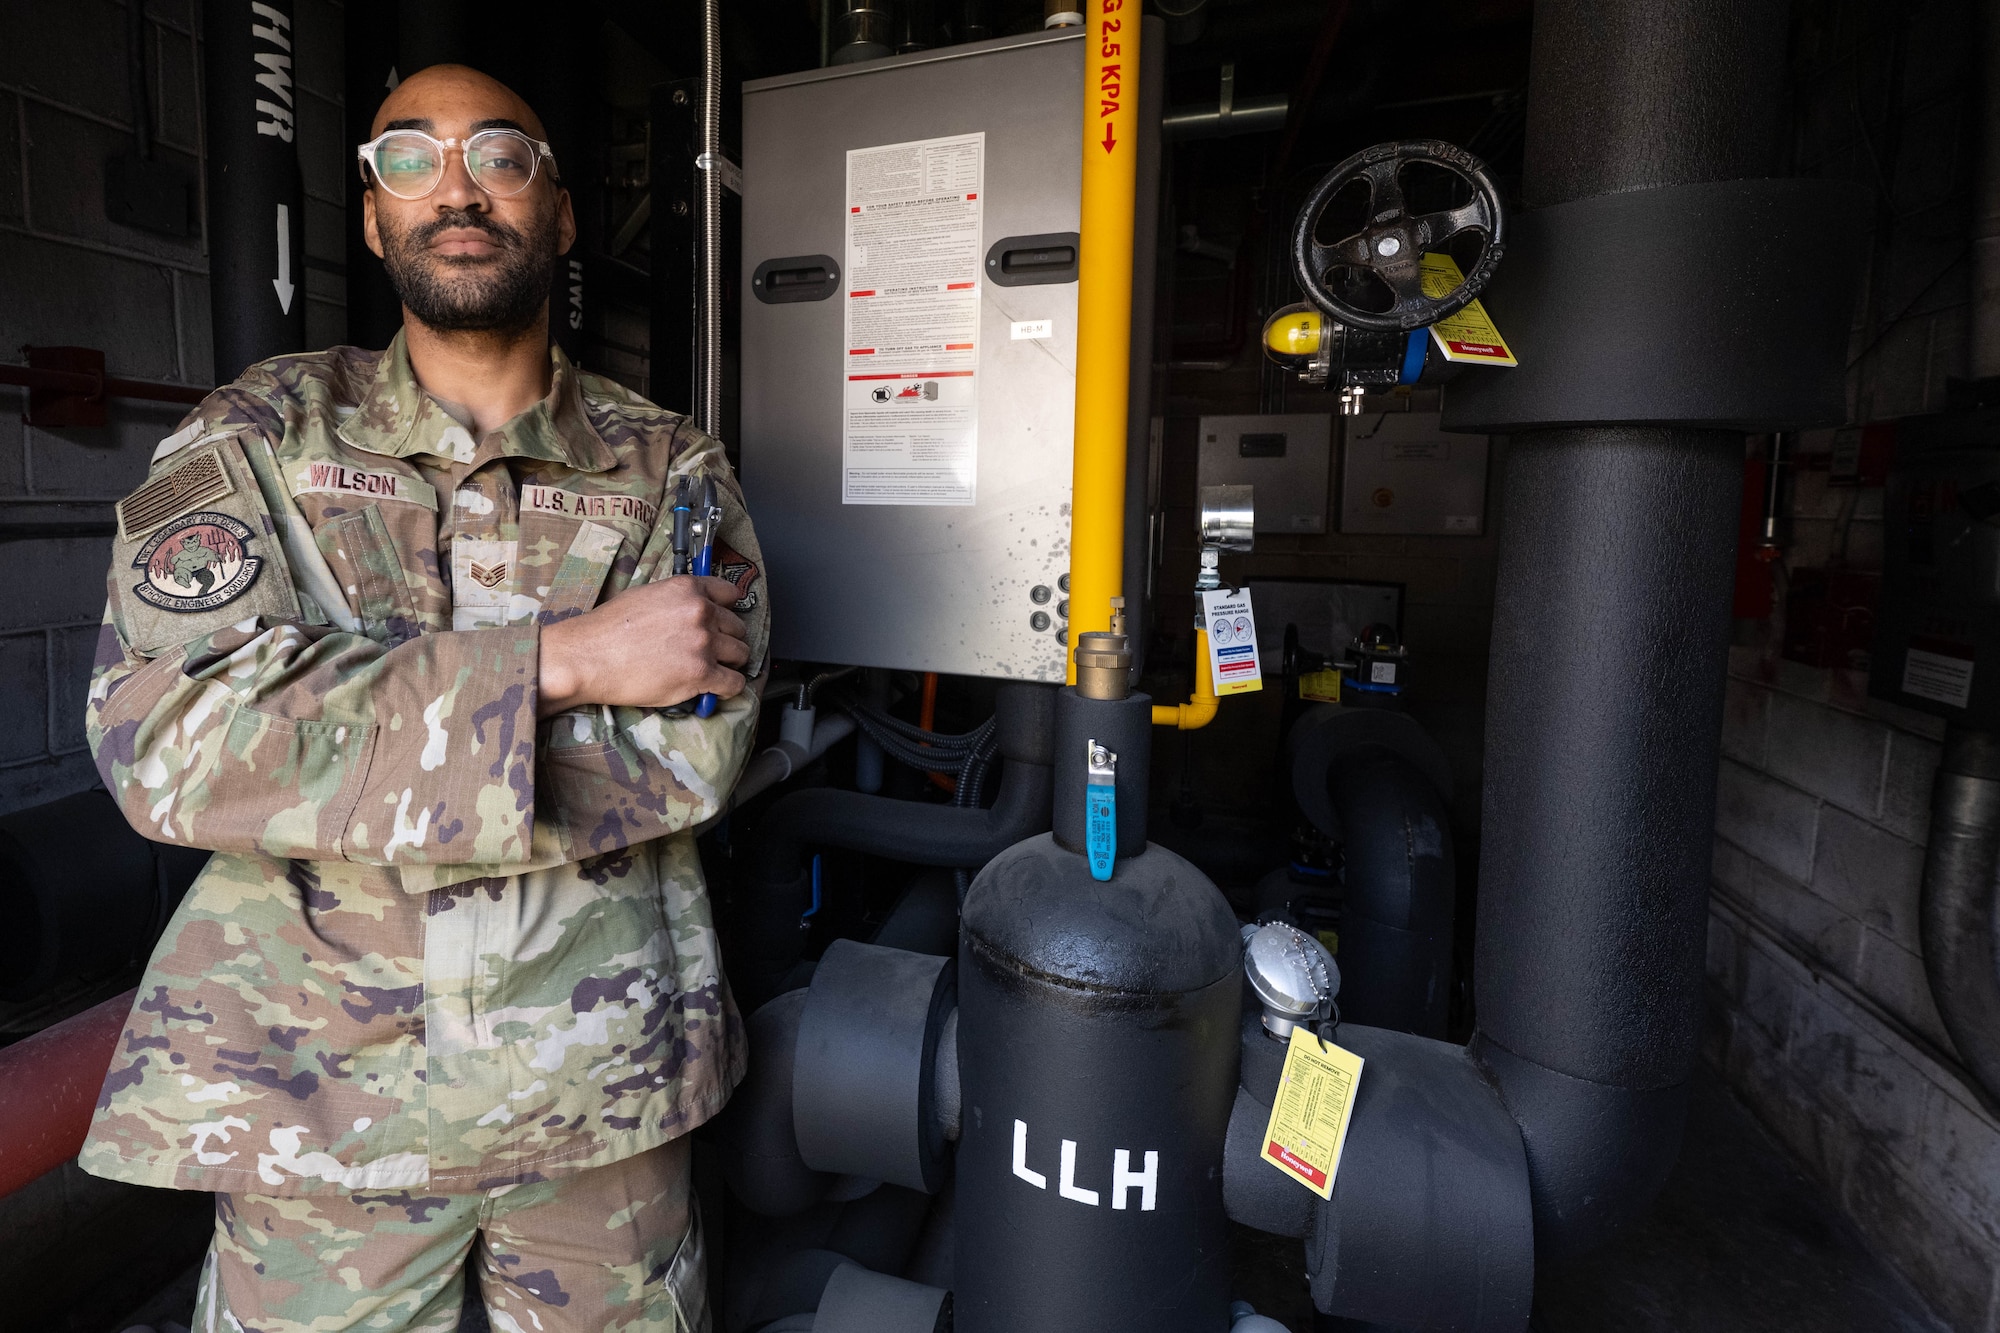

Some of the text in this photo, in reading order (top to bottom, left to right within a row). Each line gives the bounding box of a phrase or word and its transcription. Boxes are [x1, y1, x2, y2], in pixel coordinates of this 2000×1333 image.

[1102, 18, 1121, 58] 2.5
[251, 1, 294, 143] HWR
[1101, 64, 1121, 118] KPA
[1430, 142, 1482, 174] OPEN
[569, 260, 583, 330] HWS
[1461, 344, 1494, 354] Honeywell
[310, 463, 396, 496] WILSON
[533, 488, 569, 513] U.S.
[575, 496, 605, 517] AIR
[151, 516, 197, 550] LEGENDARY
[200, 514, 219, 525] RED
[220, 516, 248, 539] DEVILS
[174, 594, 224, 608] ENGINEER
[226, 558, 257, 597] SQUADRON
[1311, 1057, 1322, 1067] NOT
[1321, 1062, 1340, 1076] REMOVE
[1280, 1152, 1314, 1177] Honeywell
